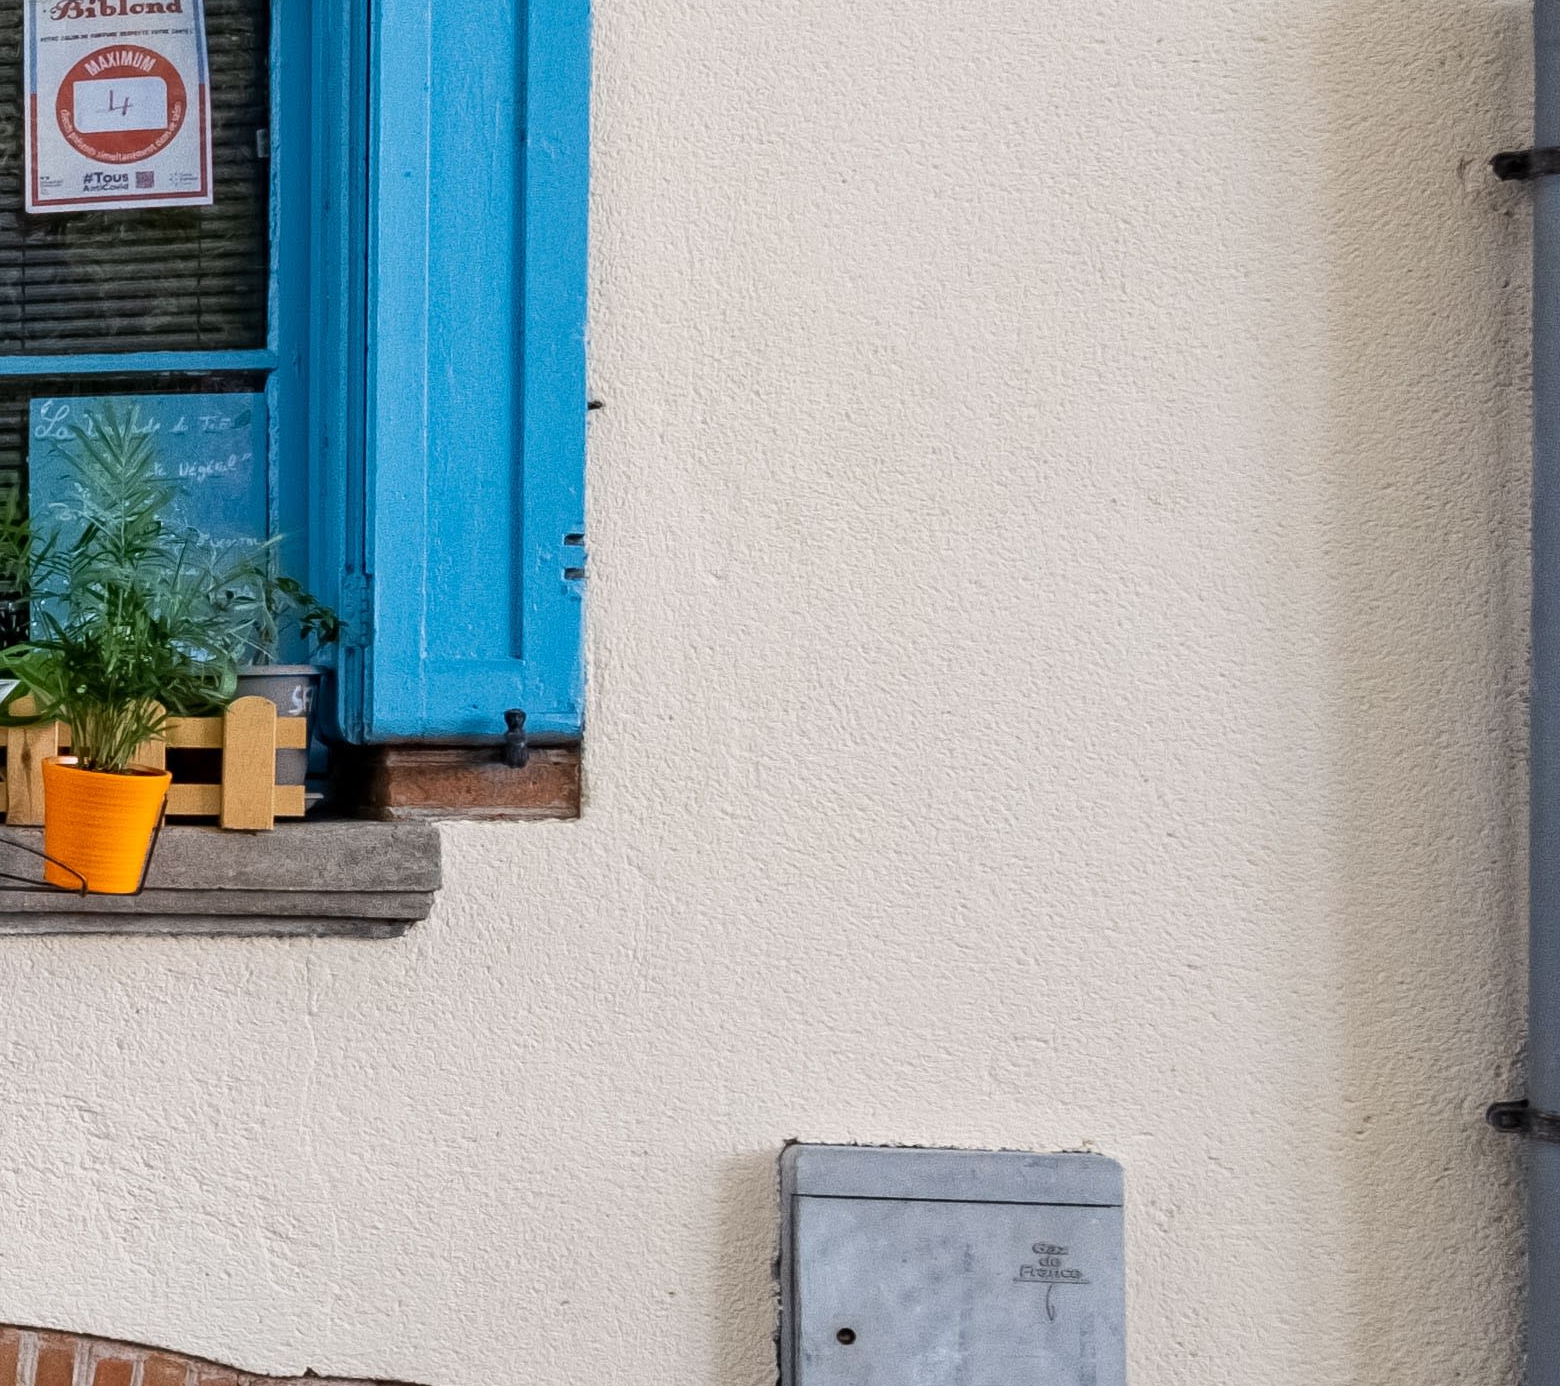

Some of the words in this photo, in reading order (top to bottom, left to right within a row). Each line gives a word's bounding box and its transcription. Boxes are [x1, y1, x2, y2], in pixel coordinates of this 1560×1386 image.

[84, 50, 156, 76] MAXIMUM
[108, 89, 133, 116] 4
[83, 171, 129, 183] #Tous
